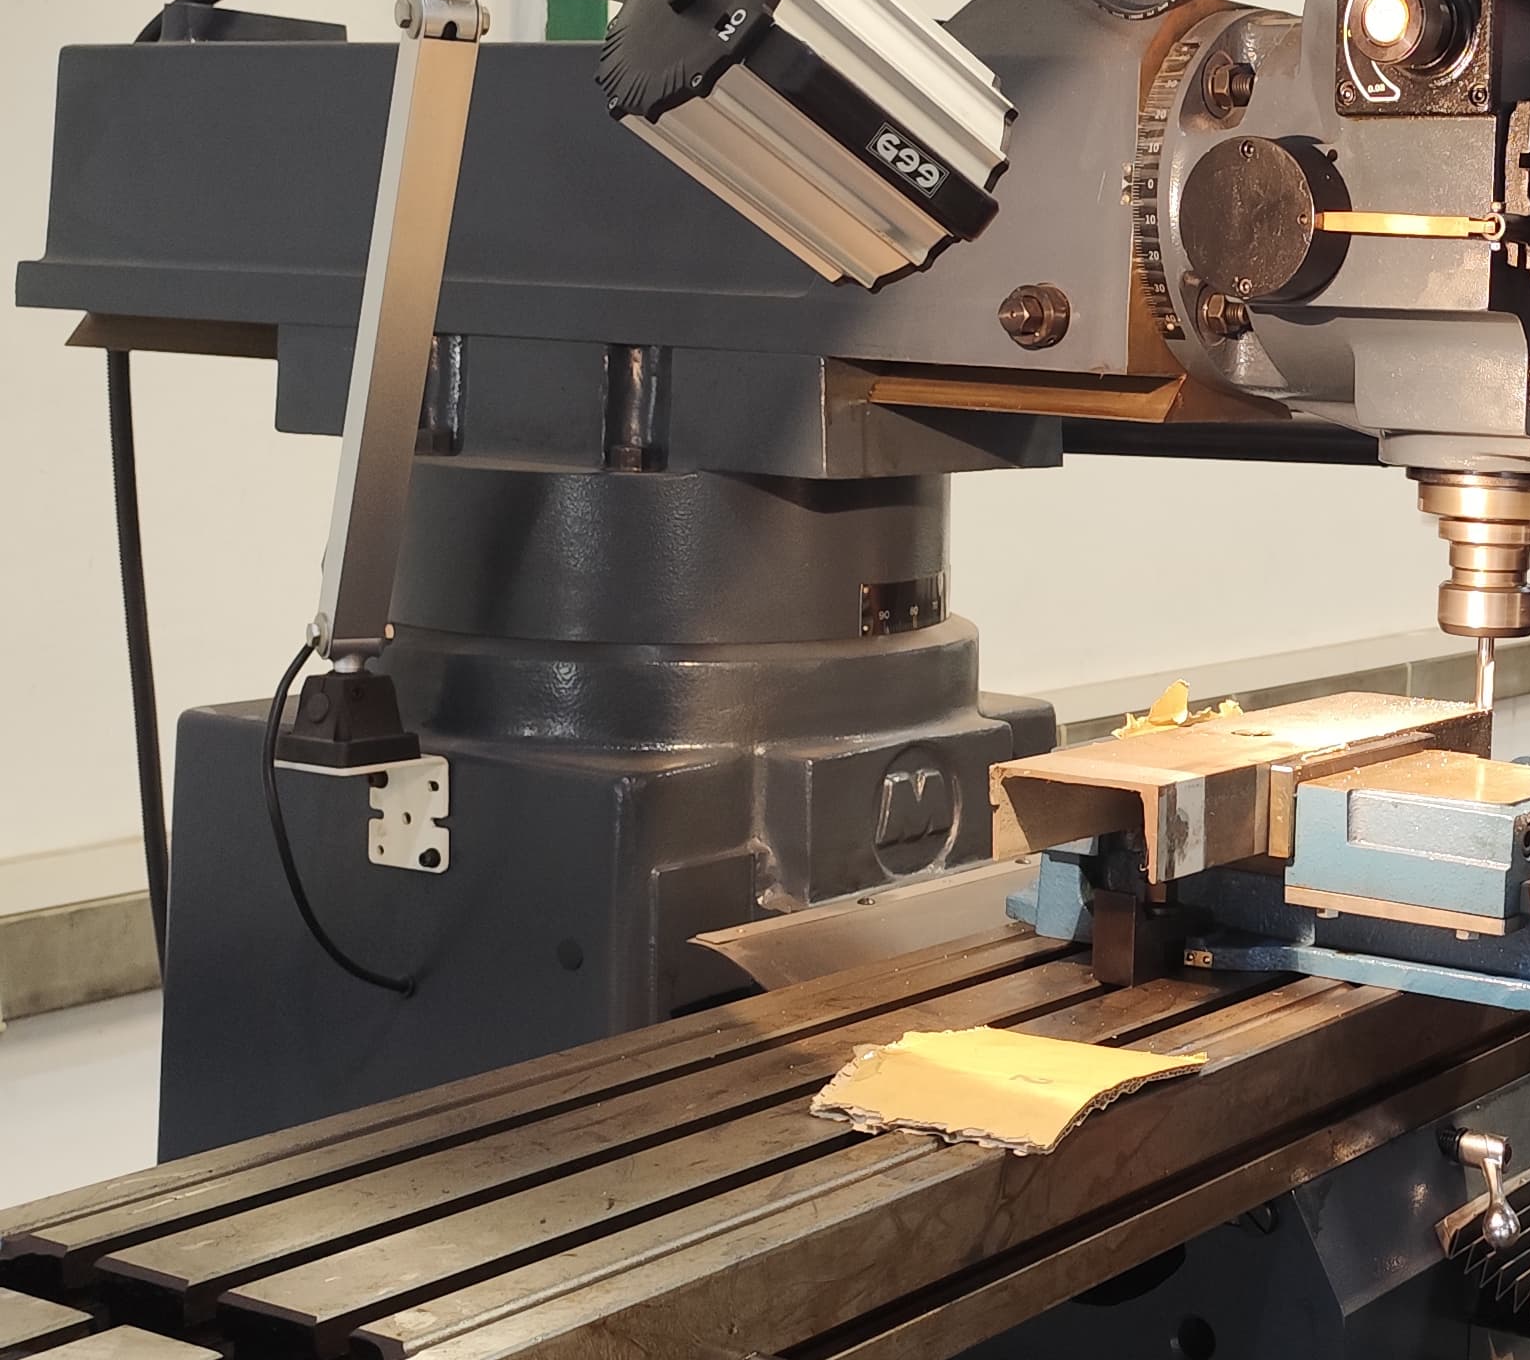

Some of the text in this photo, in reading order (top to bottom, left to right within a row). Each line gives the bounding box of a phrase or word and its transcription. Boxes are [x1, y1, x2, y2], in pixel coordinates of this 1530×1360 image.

[1148, 143, 1160, 153] 10
[1144, 214, 1156, 225] 10
[1148, 250, 1160, 261] 20
[1154, 283, 1166, 294] 30
